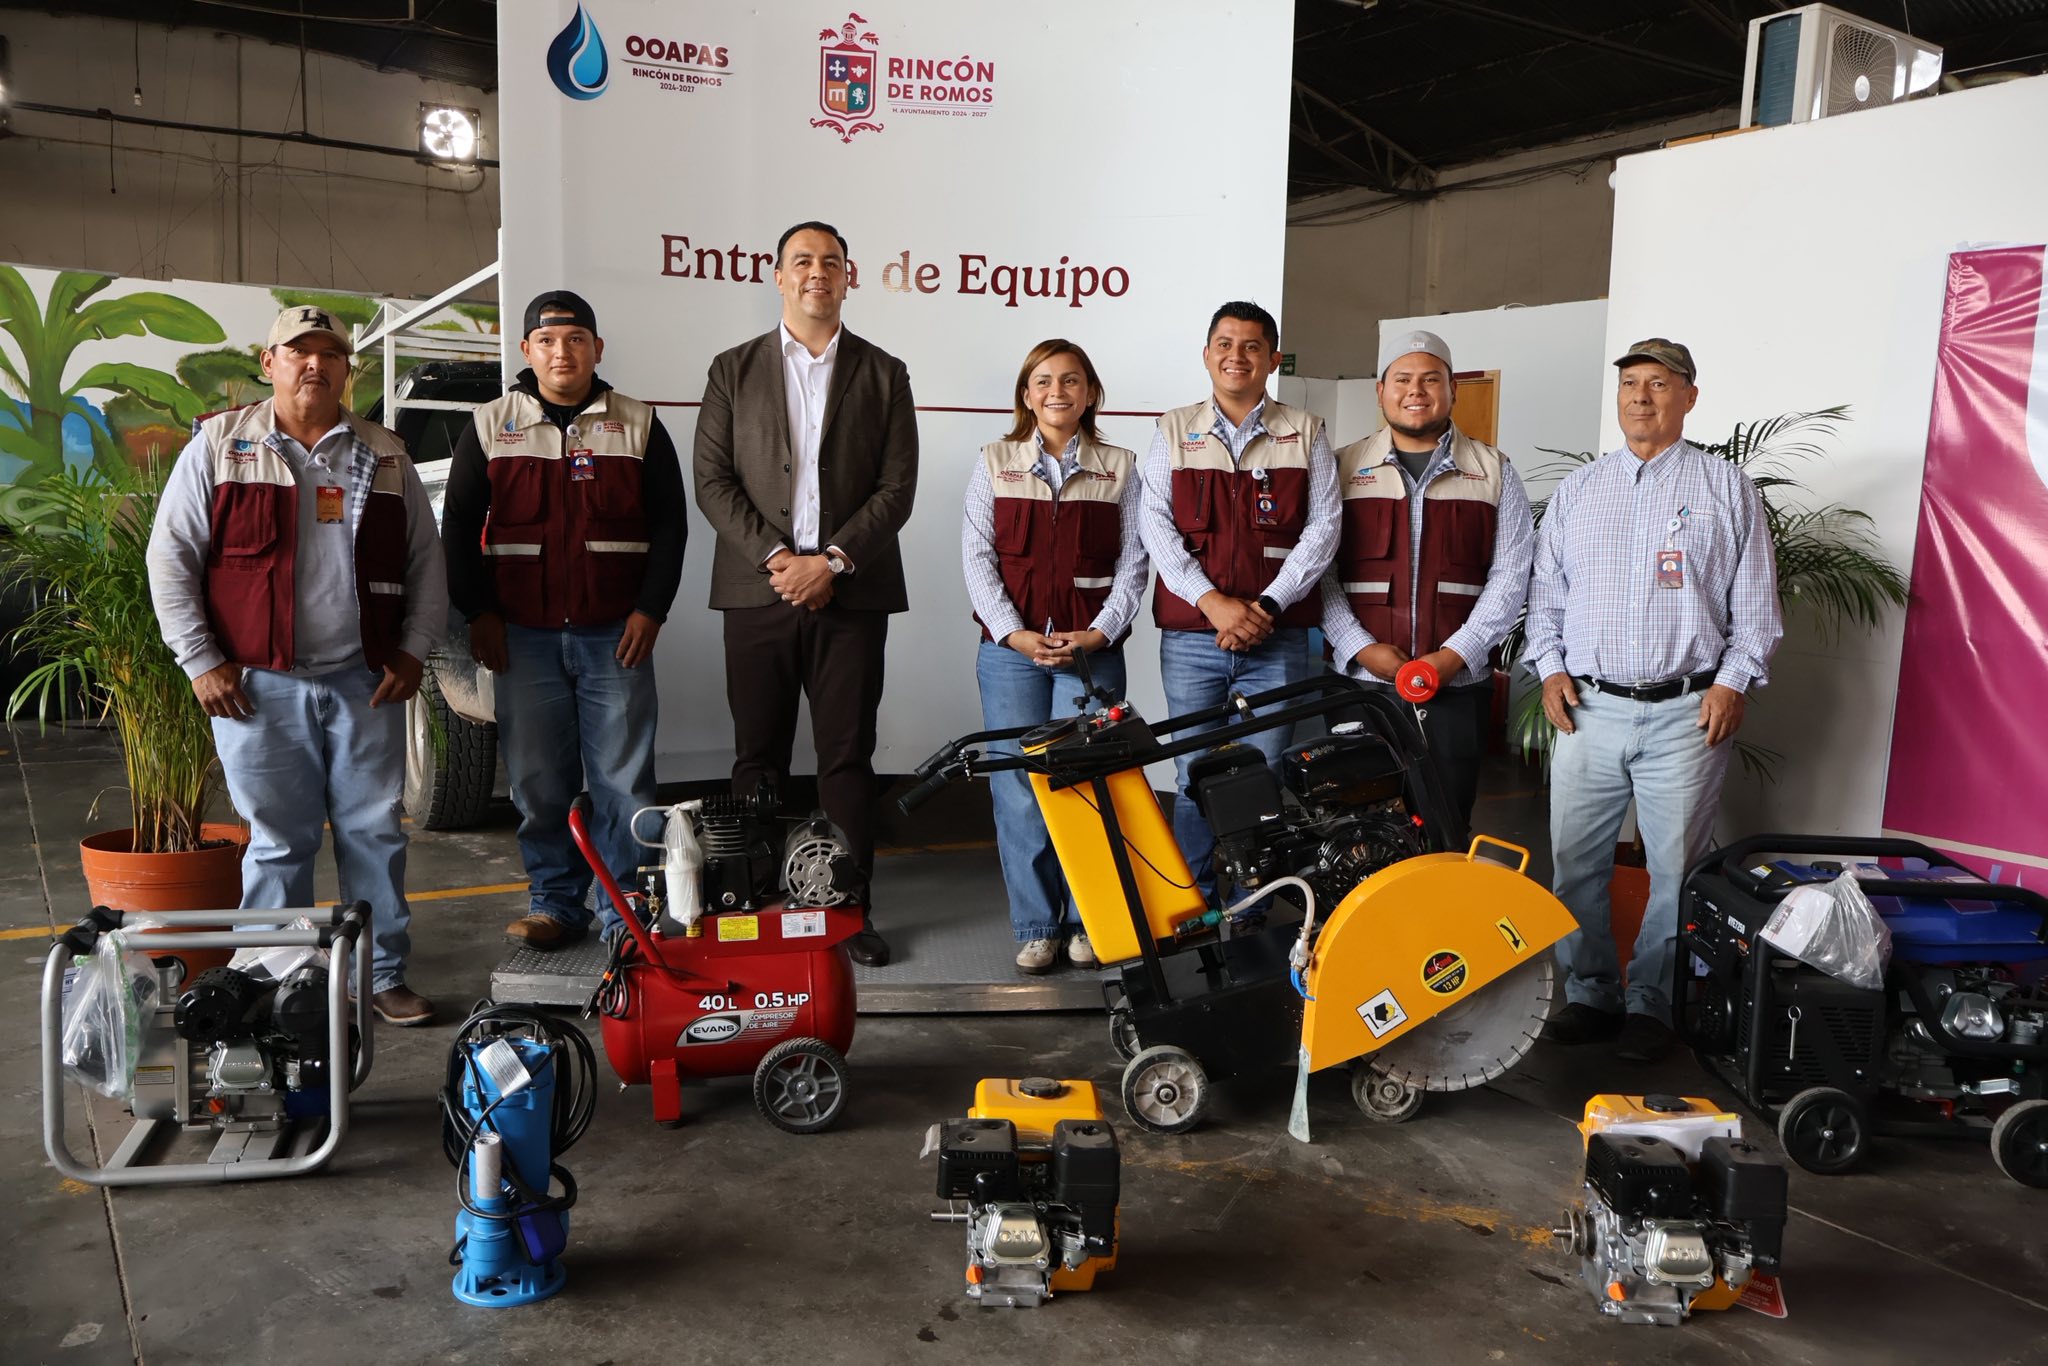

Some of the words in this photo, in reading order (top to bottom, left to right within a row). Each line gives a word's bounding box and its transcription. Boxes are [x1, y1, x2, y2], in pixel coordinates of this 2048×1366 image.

[625, 35, 729, 68] OOAPAS
[632, 67, 671, 81] RINCÓN
[672, 73, 685, 83] DE
[686, 75, 722, 87] ROMOS
[887, 55, 994, 83] RINCÓN
[660, 82, 695, 93] 2024-2027
[887, 83, 914, 100] DE
[920, 85, 993, 103] ROMOS
[900, 108, 950, 117] AYUNTAMIENTO
[660, 234, 860, 289] Entra
[882, 250, 941, 294] de
[957, 253, 1131, 308] Equipo
[300, 309, 333, 331] LA
[1442, 981, 1453, 991] 13
[1450, 975, 1460, 987] HP
[698, 995, 725, 1011] 40
[728, 997, 738, 1010] L
[754, 992, 785, 1009] 0.5
[787, 993, 810, 1007] HP
[748, 1012, 794, 1021] COMPRESOR
[693, 1025, 735, 1034] EVANS
